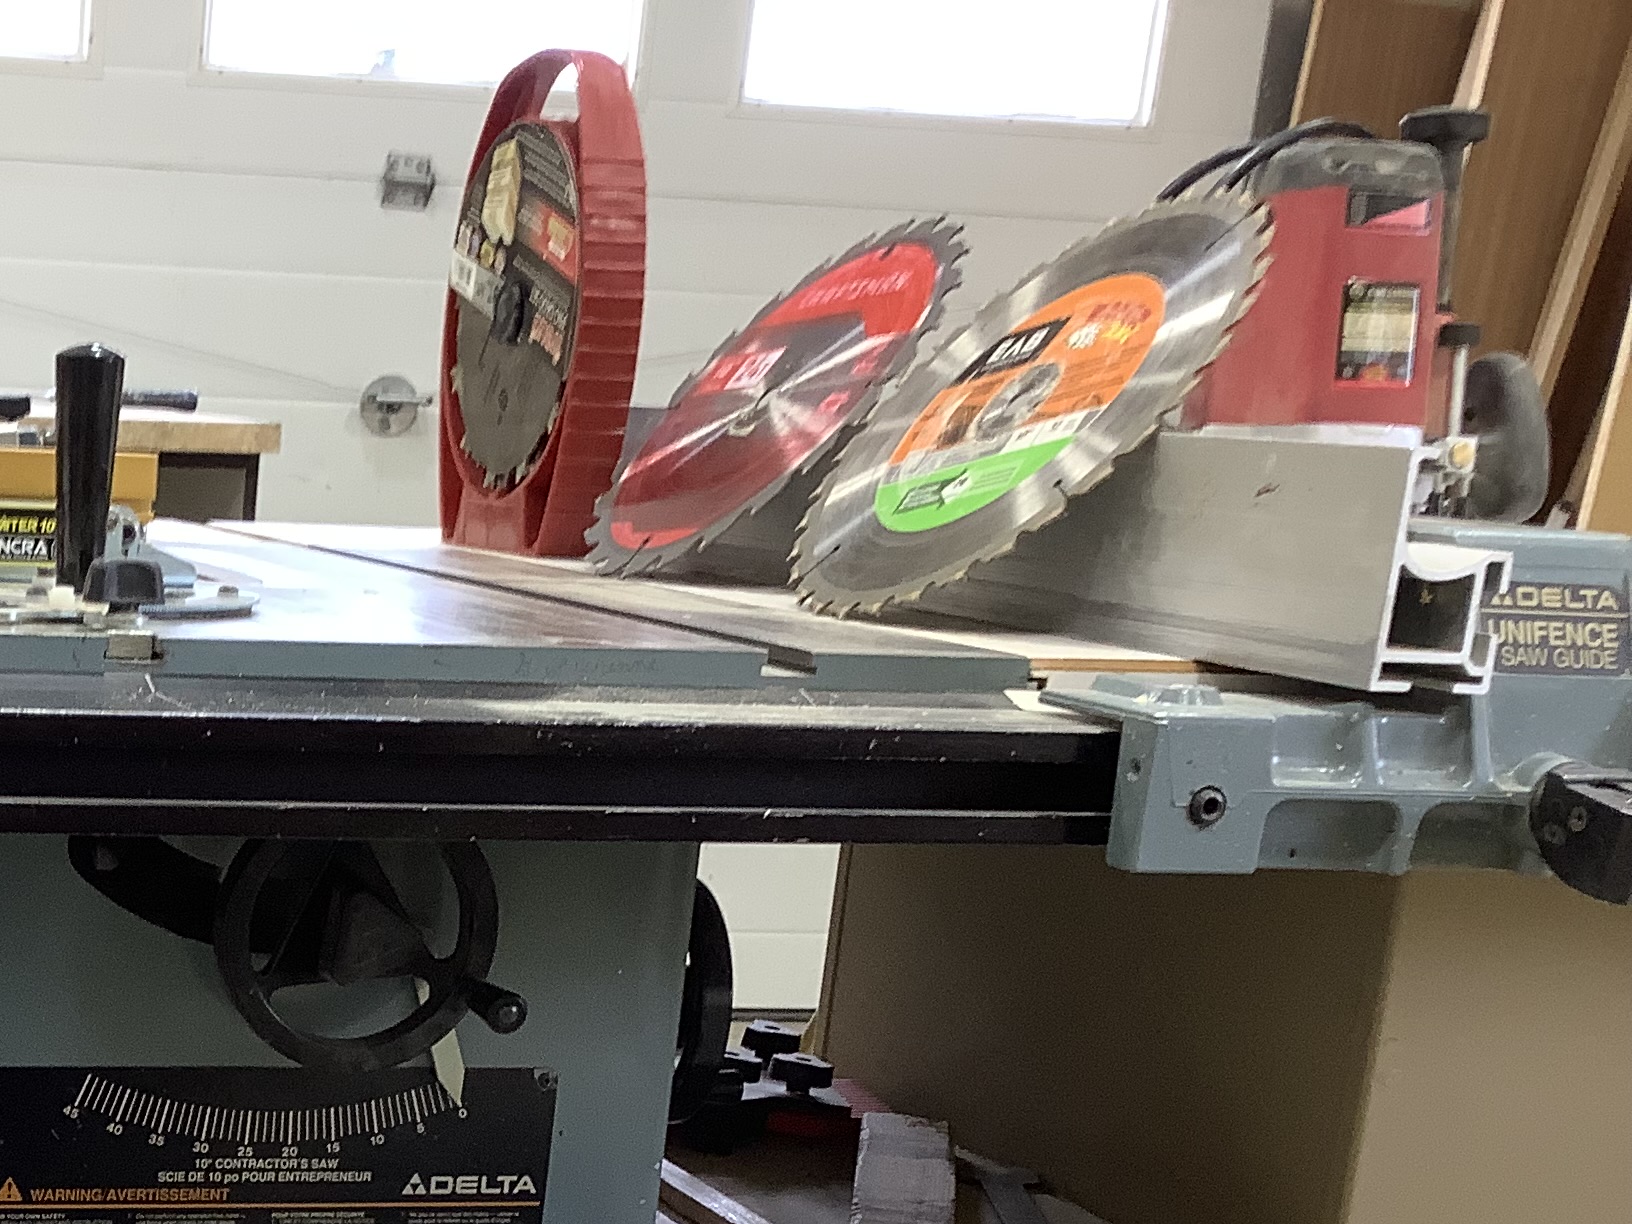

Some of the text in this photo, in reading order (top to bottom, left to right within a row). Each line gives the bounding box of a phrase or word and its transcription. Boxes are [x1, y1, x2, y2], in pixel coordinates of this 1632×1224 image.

[1516, 585, 1618, 611] DELTA
[1487, 619, 1619, 648] UNIFENCE
[1501, 646, 1618, 670] SAW GUIDE
[63, 1105, 467, 1157] 45 40 35 30 25 20 15 10 5 0
[215, 1158, 308, 1169] CONTRACTOR'S
[311, 1158, 340, 1169] SAW
[158, 1171, 372, 1184] SCIE DE 10 po POUR ENTREPRENEUR
[429, 1175, 537, 1195] DELTA
